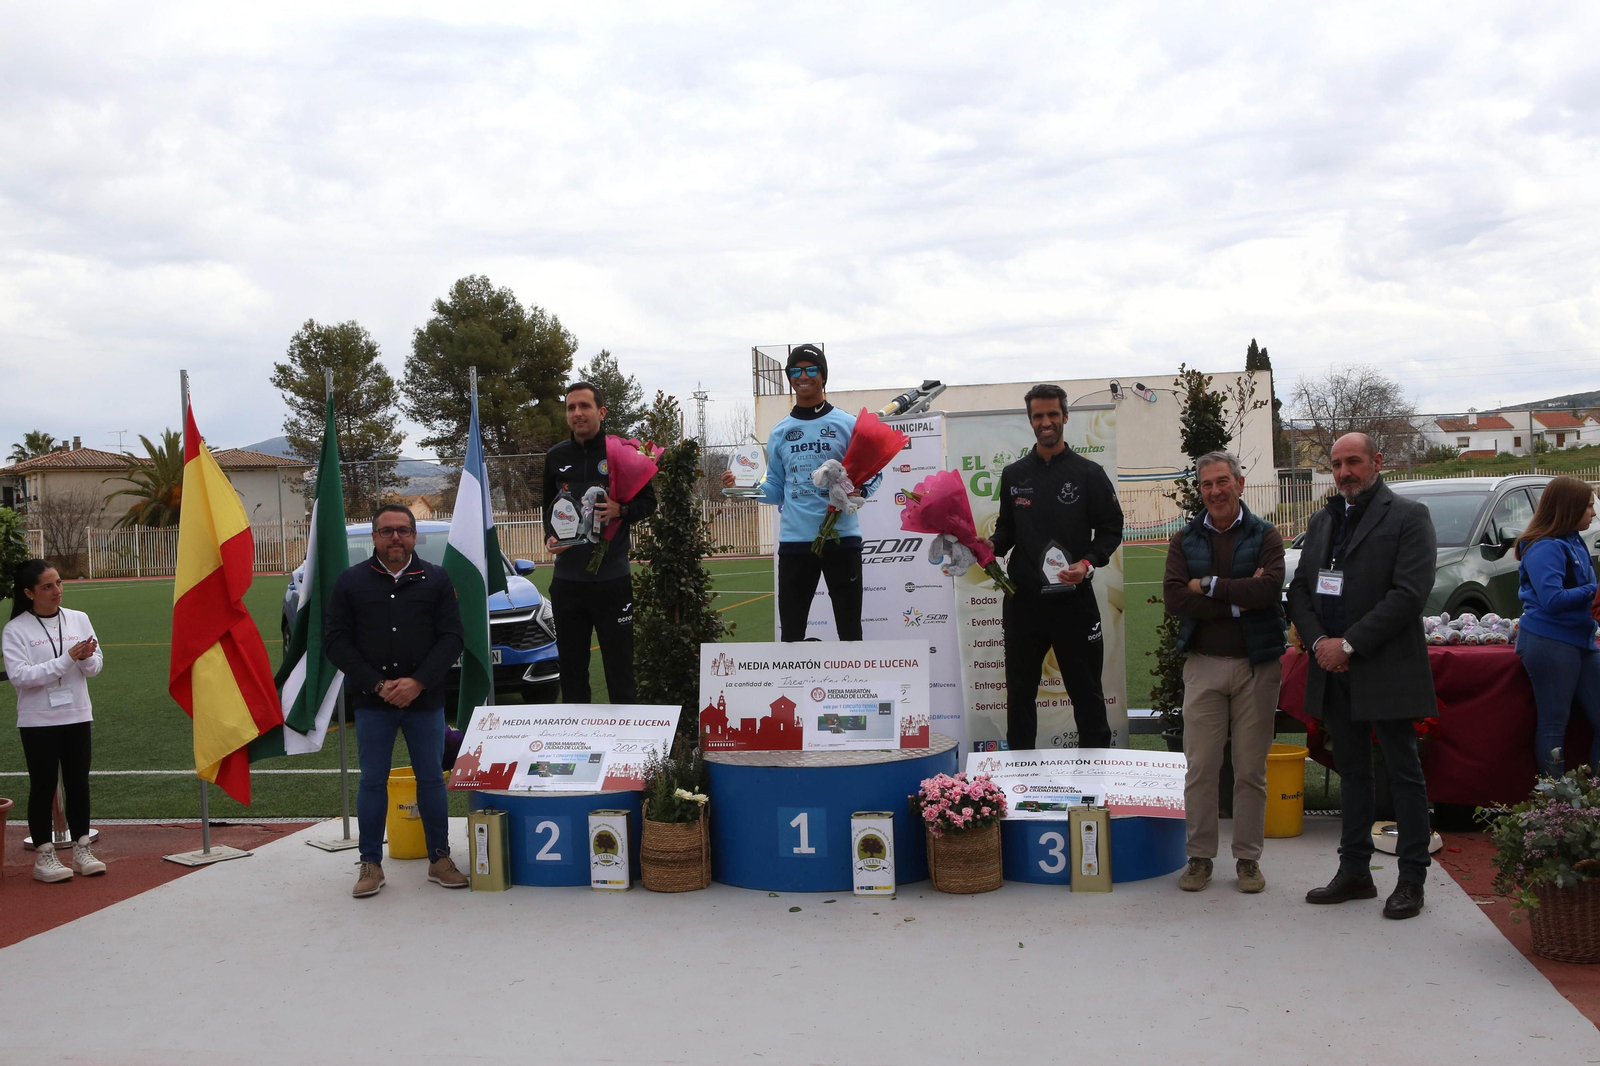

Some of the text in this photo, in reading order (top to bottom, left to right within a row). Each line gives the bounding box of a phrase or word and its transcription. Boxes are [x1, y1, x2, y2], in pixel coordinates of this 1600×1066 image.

[891, 422, 934, 433] UNICIPAL
[790, 439, 832, 454] nerja
[1070, 445, 1105, 454] lantas
[962, 456, 986, 471] EL
[862, 538, 923, 555] SDM
[862, 556, 915, 564] ucena
[970, 596, 998, 605] Bodas
[972, 618, 1004, 626] Eventos
[30, 636, 50, 648] Calvin
[973, 639, 1005, 648] Jardine
[738, 658, 919, 670] MEDIA MARATÓN CIUDAD DE LUCENA
[974, 660, 1004, 670] Paisajis
[1038, 678, 1061, 687] icilio
[533, 717, 579, 726] MARATÓN
[612, 743, 637, 752] 200
[790, 812, 816, 854] 1
[535, 820, 562, 860] 2
[1038, 832, 1066, 874] 3
